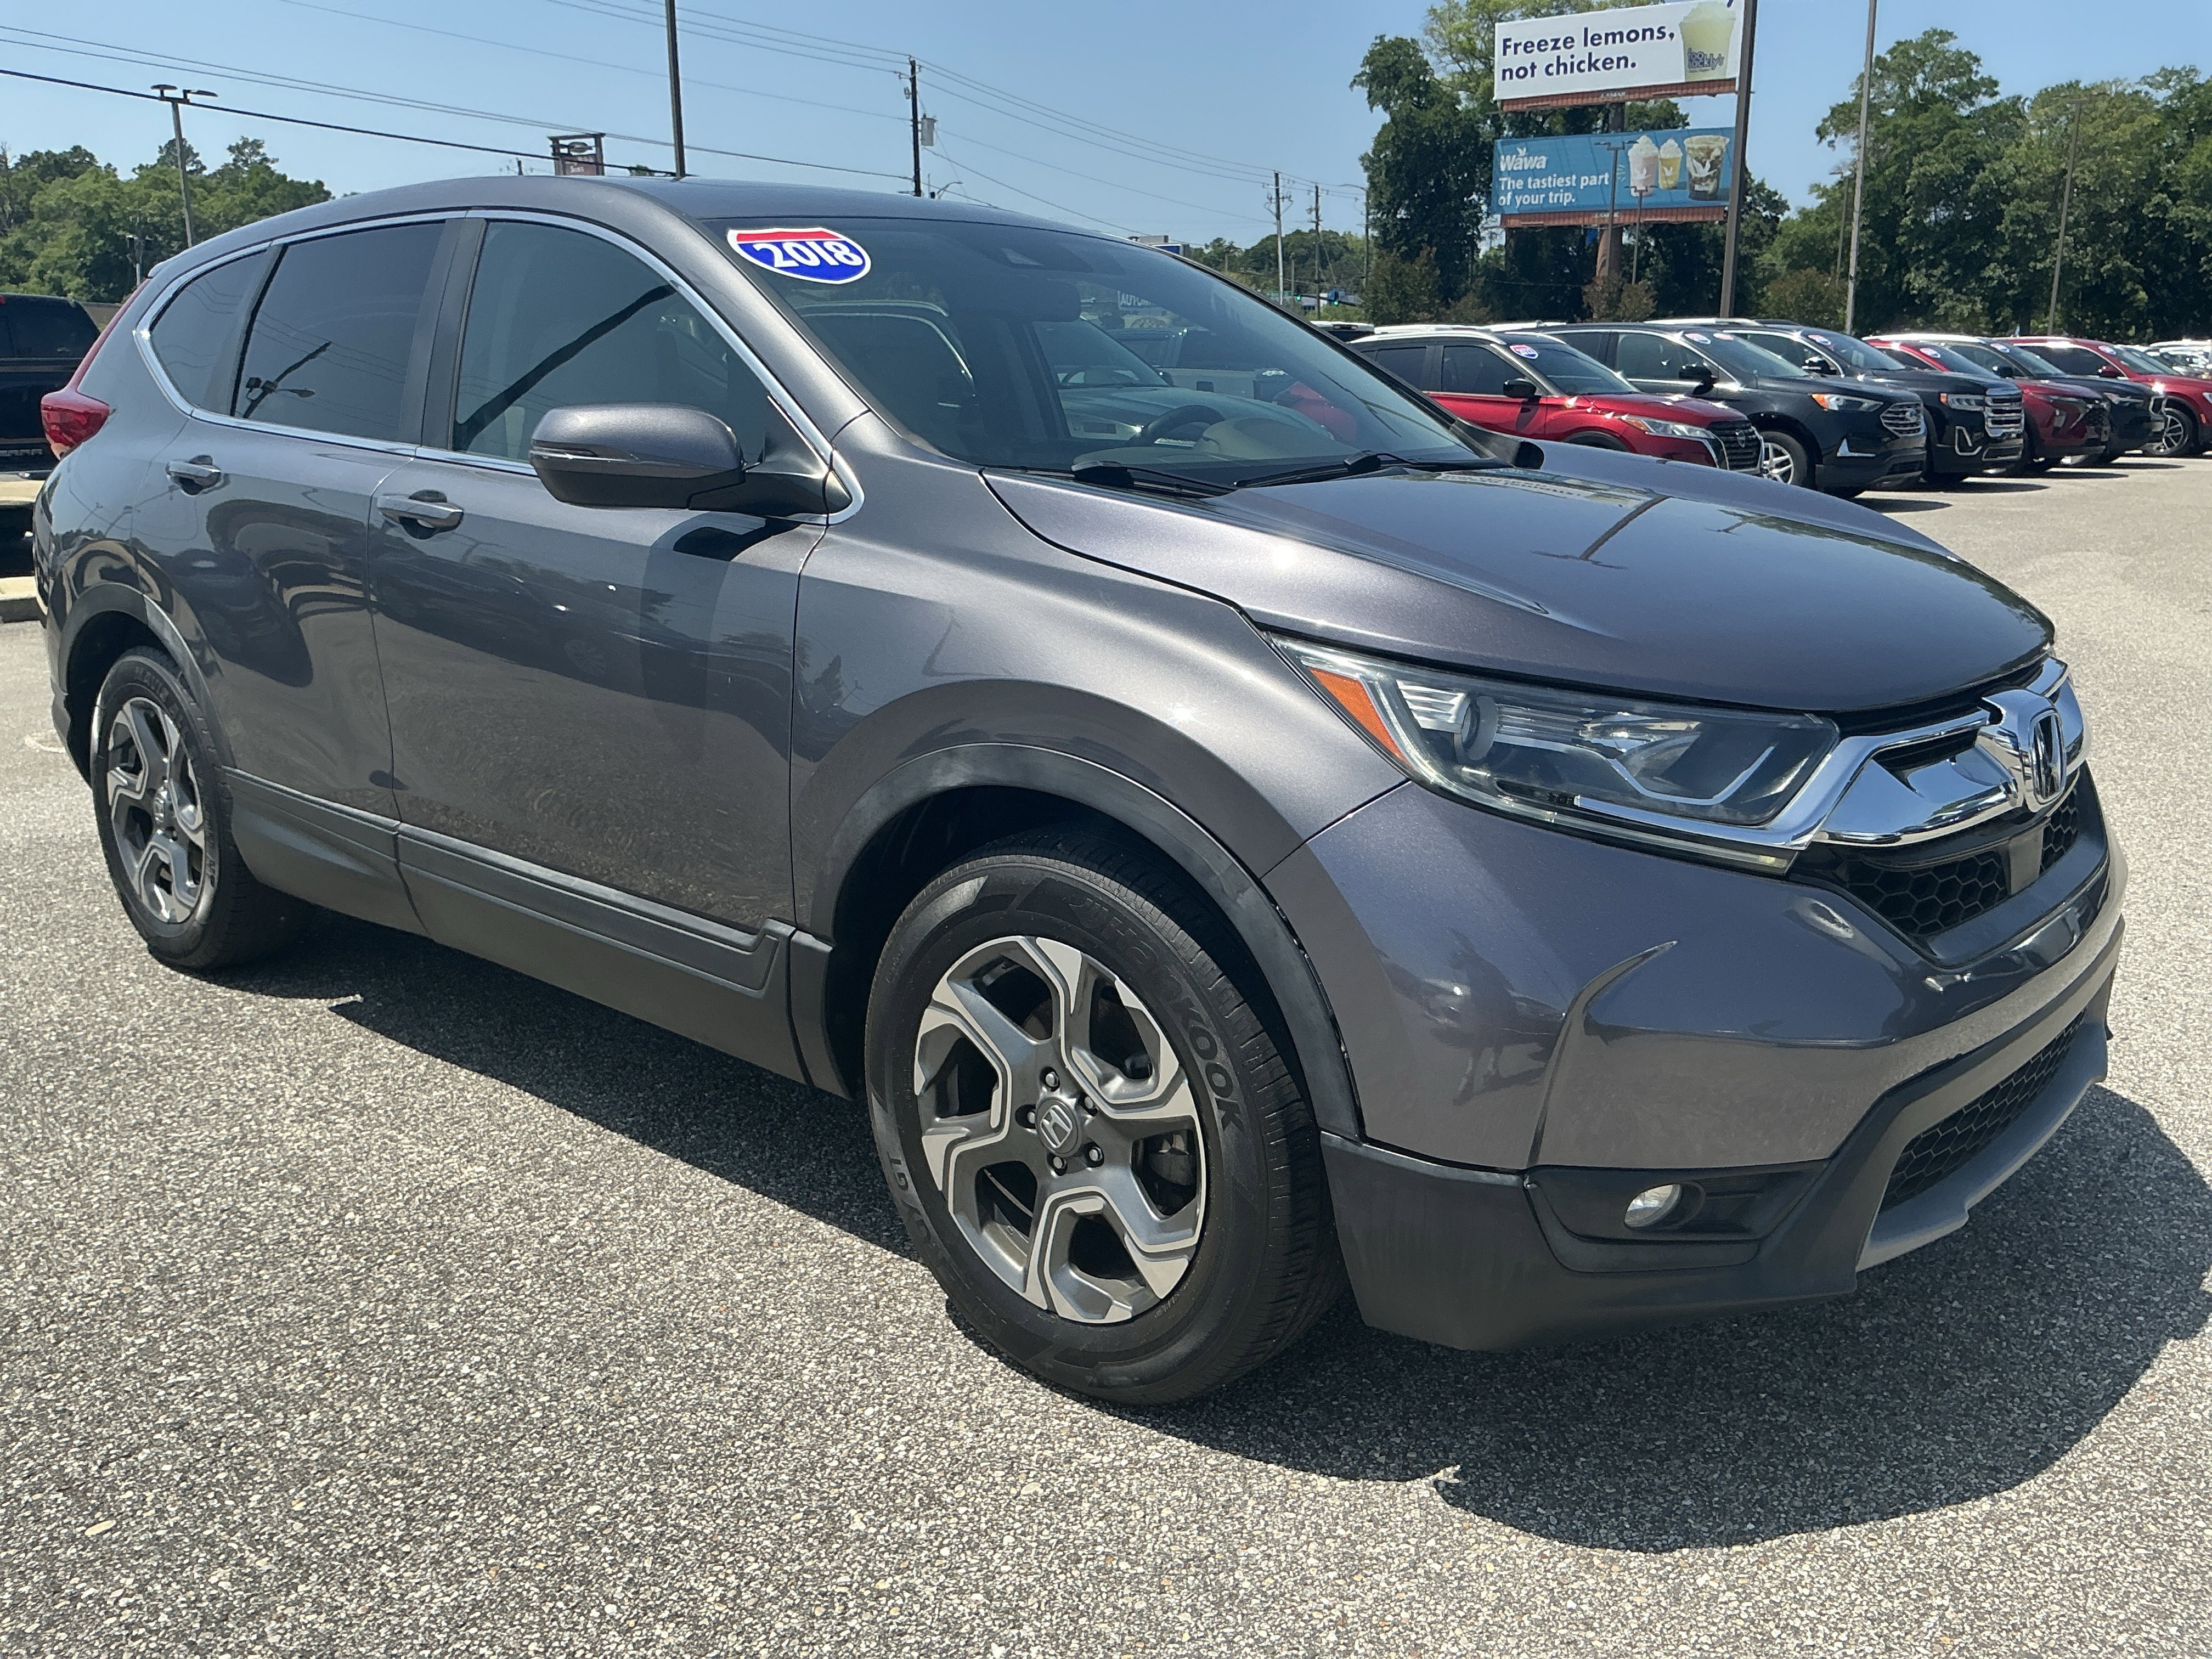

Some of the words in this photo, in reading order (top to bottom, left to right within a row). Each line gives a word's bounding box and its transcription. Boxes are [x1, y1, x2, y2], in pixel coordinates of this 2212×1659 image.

[1502, 36, 1575, 56] Freeze
[1583, 25, 1675, 47] lemons,
[1502, 61, 1537, 81] not
[1544, 52, 1637, 76] chicken.
[1500, 155, 1547, 172] Wawa
[1499, 176, 1523, 190] The
[1527, 173, 1576, 189] tastiest
[1580, 172, 1609, 189] part
[1498, 190, 1513, 206] of
[1515, 194, 1545, 208] your
[1549, 189, 1576, 206] trip.
[753, 241, 863, 268] 2018
[888, 1153, 908, 1189] GT
